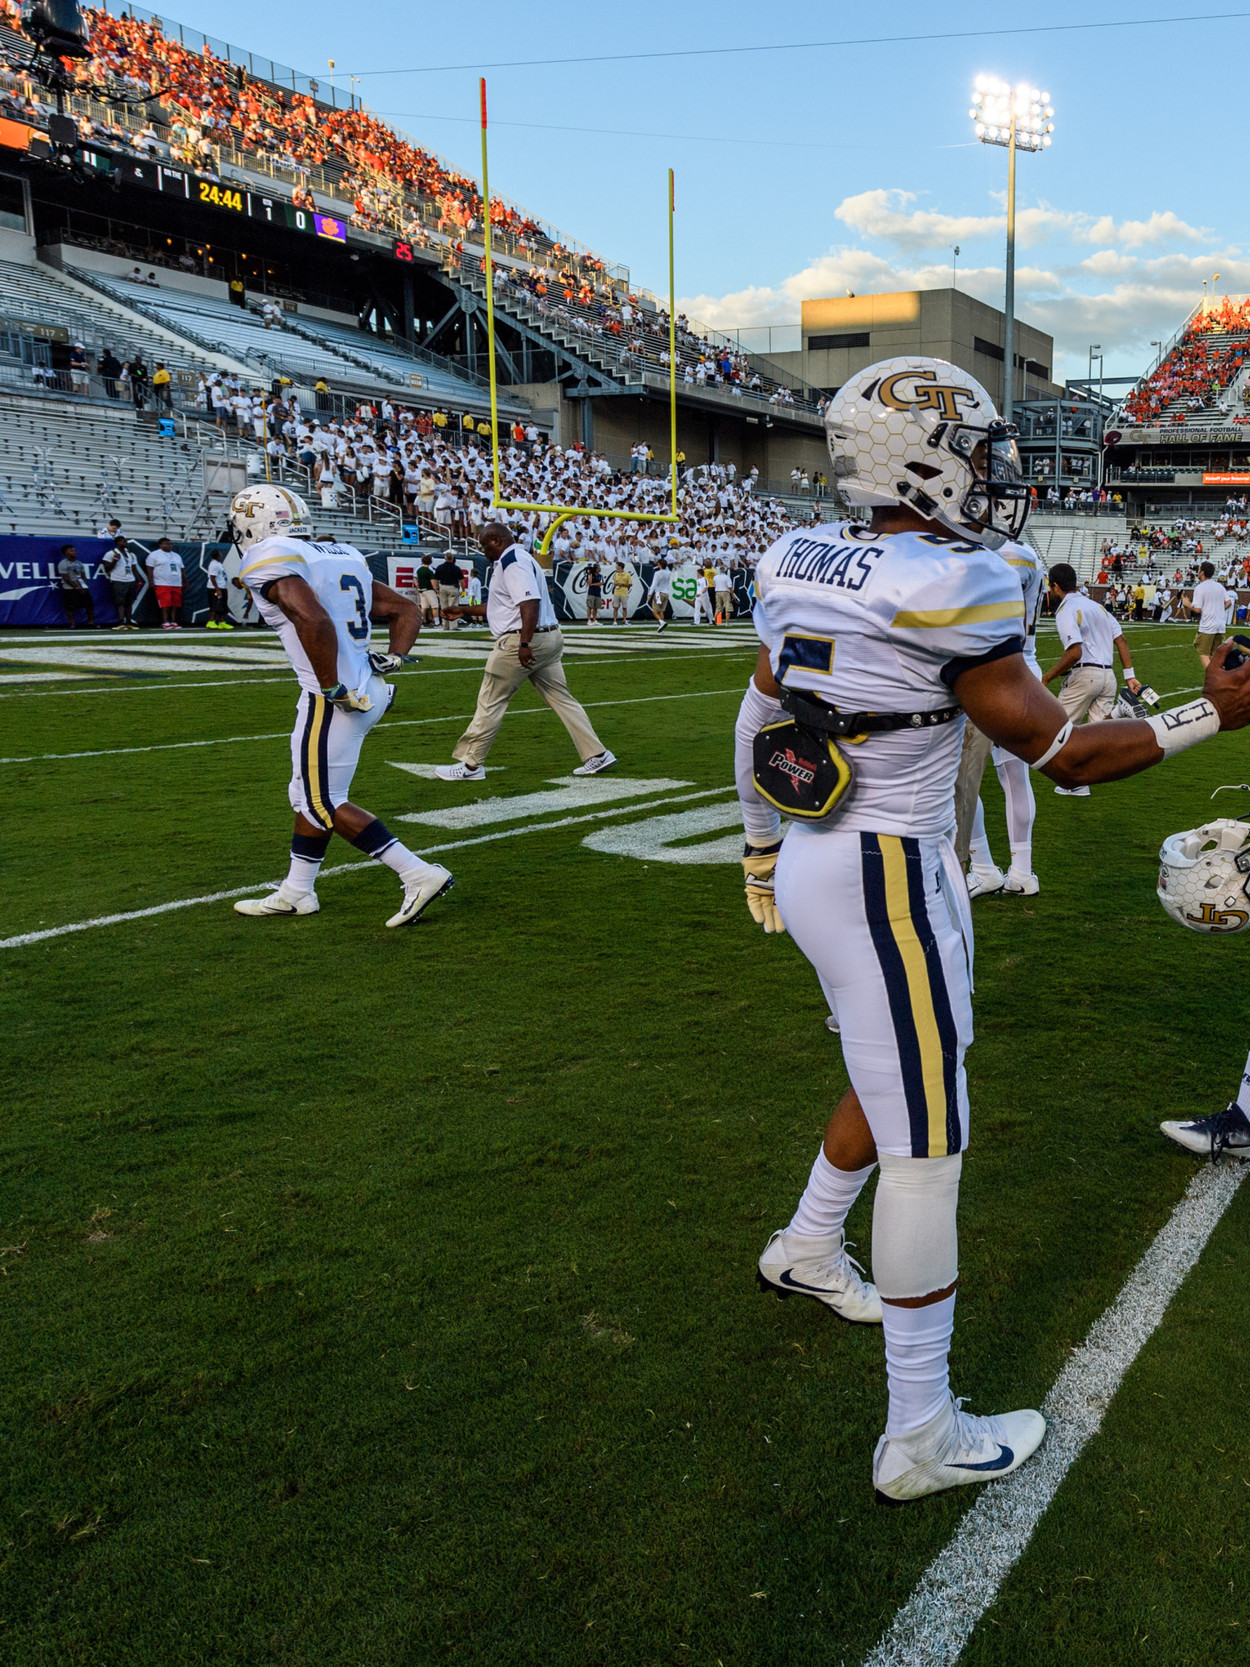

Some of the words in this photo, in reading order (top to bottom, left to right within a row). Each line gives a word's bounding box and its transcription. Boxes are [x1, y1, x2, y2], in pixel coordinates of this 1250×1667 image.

[200, 182, 242, 211] 24:44
[266, 207, 272, 221] 1
[295, 211, 306, 230] 0
[395, 241, 412, 262] 25
[40, 328, 56, 336] 117
[181, 374, 192, 382] 117
[877, 370, 975, 422] GT
[1160, 434, 1188, 444] HALL
[1191, 433, 1207, 443] OF
[1209, 432, 1243, 443] FAME
[231, 494, 264, 518] GT
[775, 537, 885, 591] THOMAS
[339, 573, 369, 641] 3
[769, 751, 814, 783] POWER
